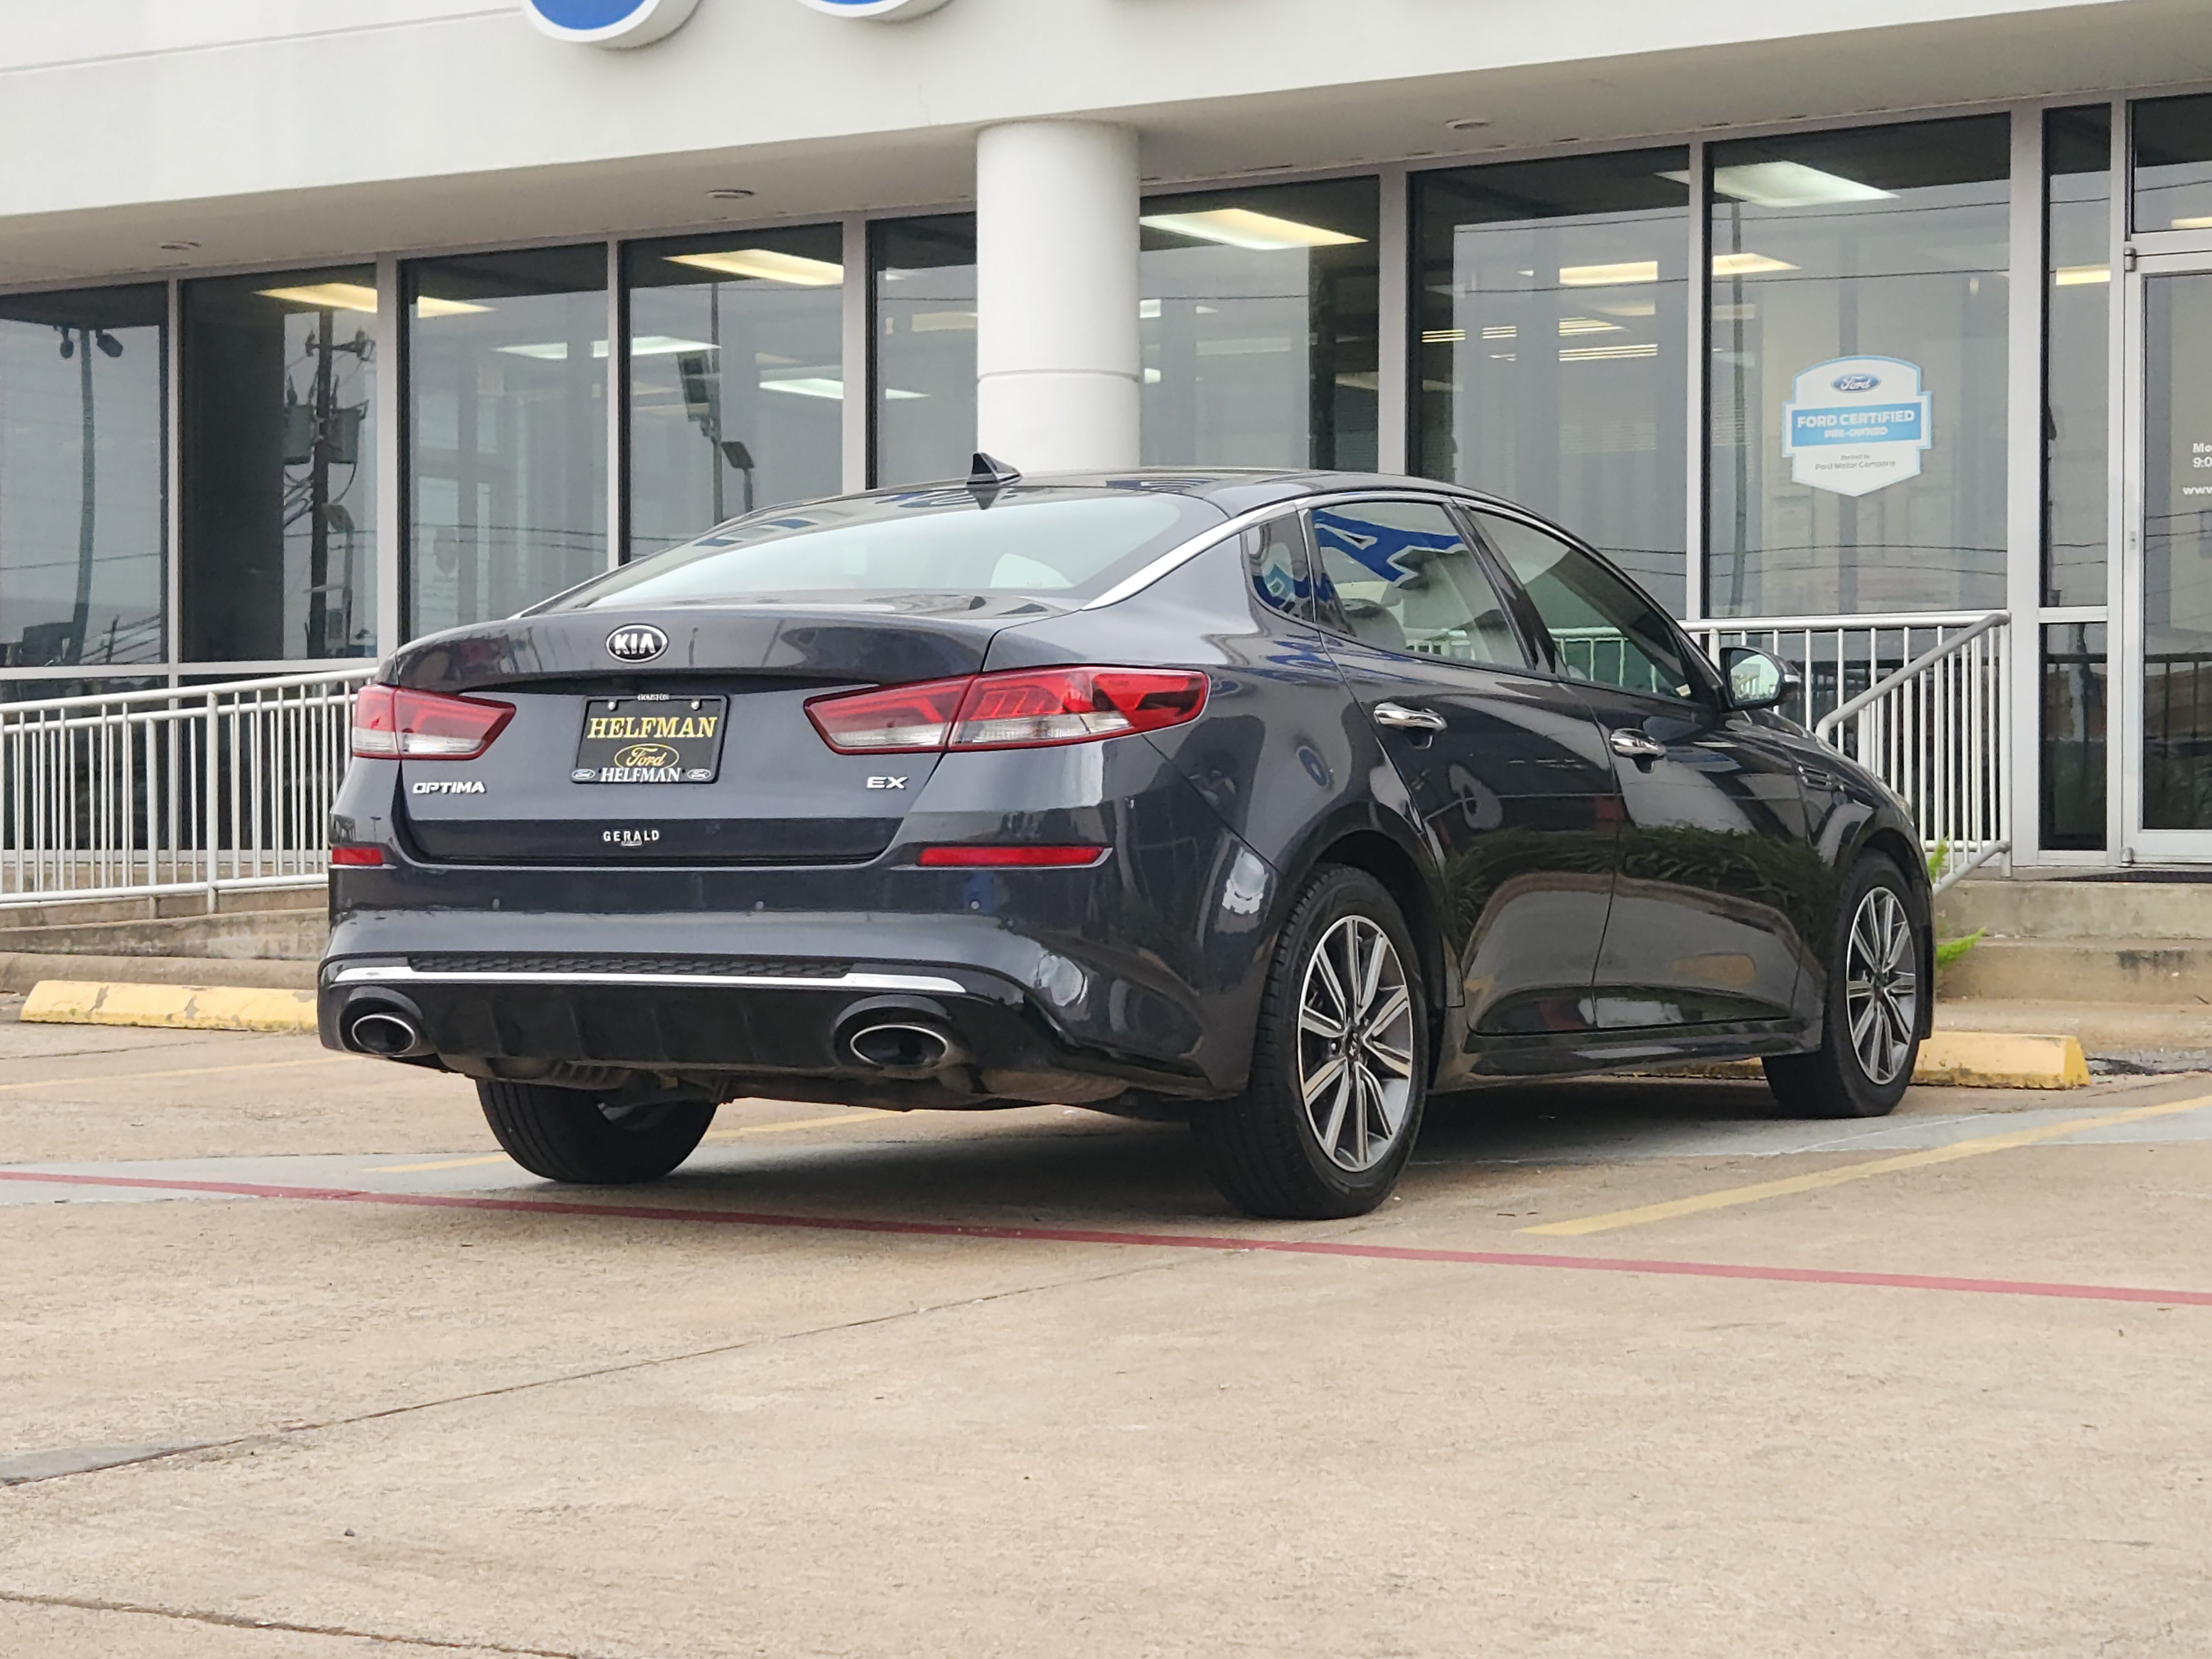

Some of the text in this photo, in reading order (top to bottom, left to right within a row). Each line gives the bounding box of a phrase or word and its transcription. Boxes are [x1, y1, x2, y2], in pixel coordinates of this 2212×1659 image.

[1841, 376, 1872, 390] Ford
[1797, 410, 1915, 428] FORD CERTIFIED
[1824, 426, 1888, 438] PRE-OWNED
[2192, 442, 2212, 453] Mo
[2193, 457, 2212, 468] 9:0
[614, 633, 656, 654] KIA
[587, 717, 718, 738] HELFMAN
[626, 747, 667, 767] Ford
[600, 768, 682, 782] HELFMAN
[413, 781, 486, 793] OPTIMA
[867, 776, 907, 788] EX
[603, 830, 660, 842] GERALD
